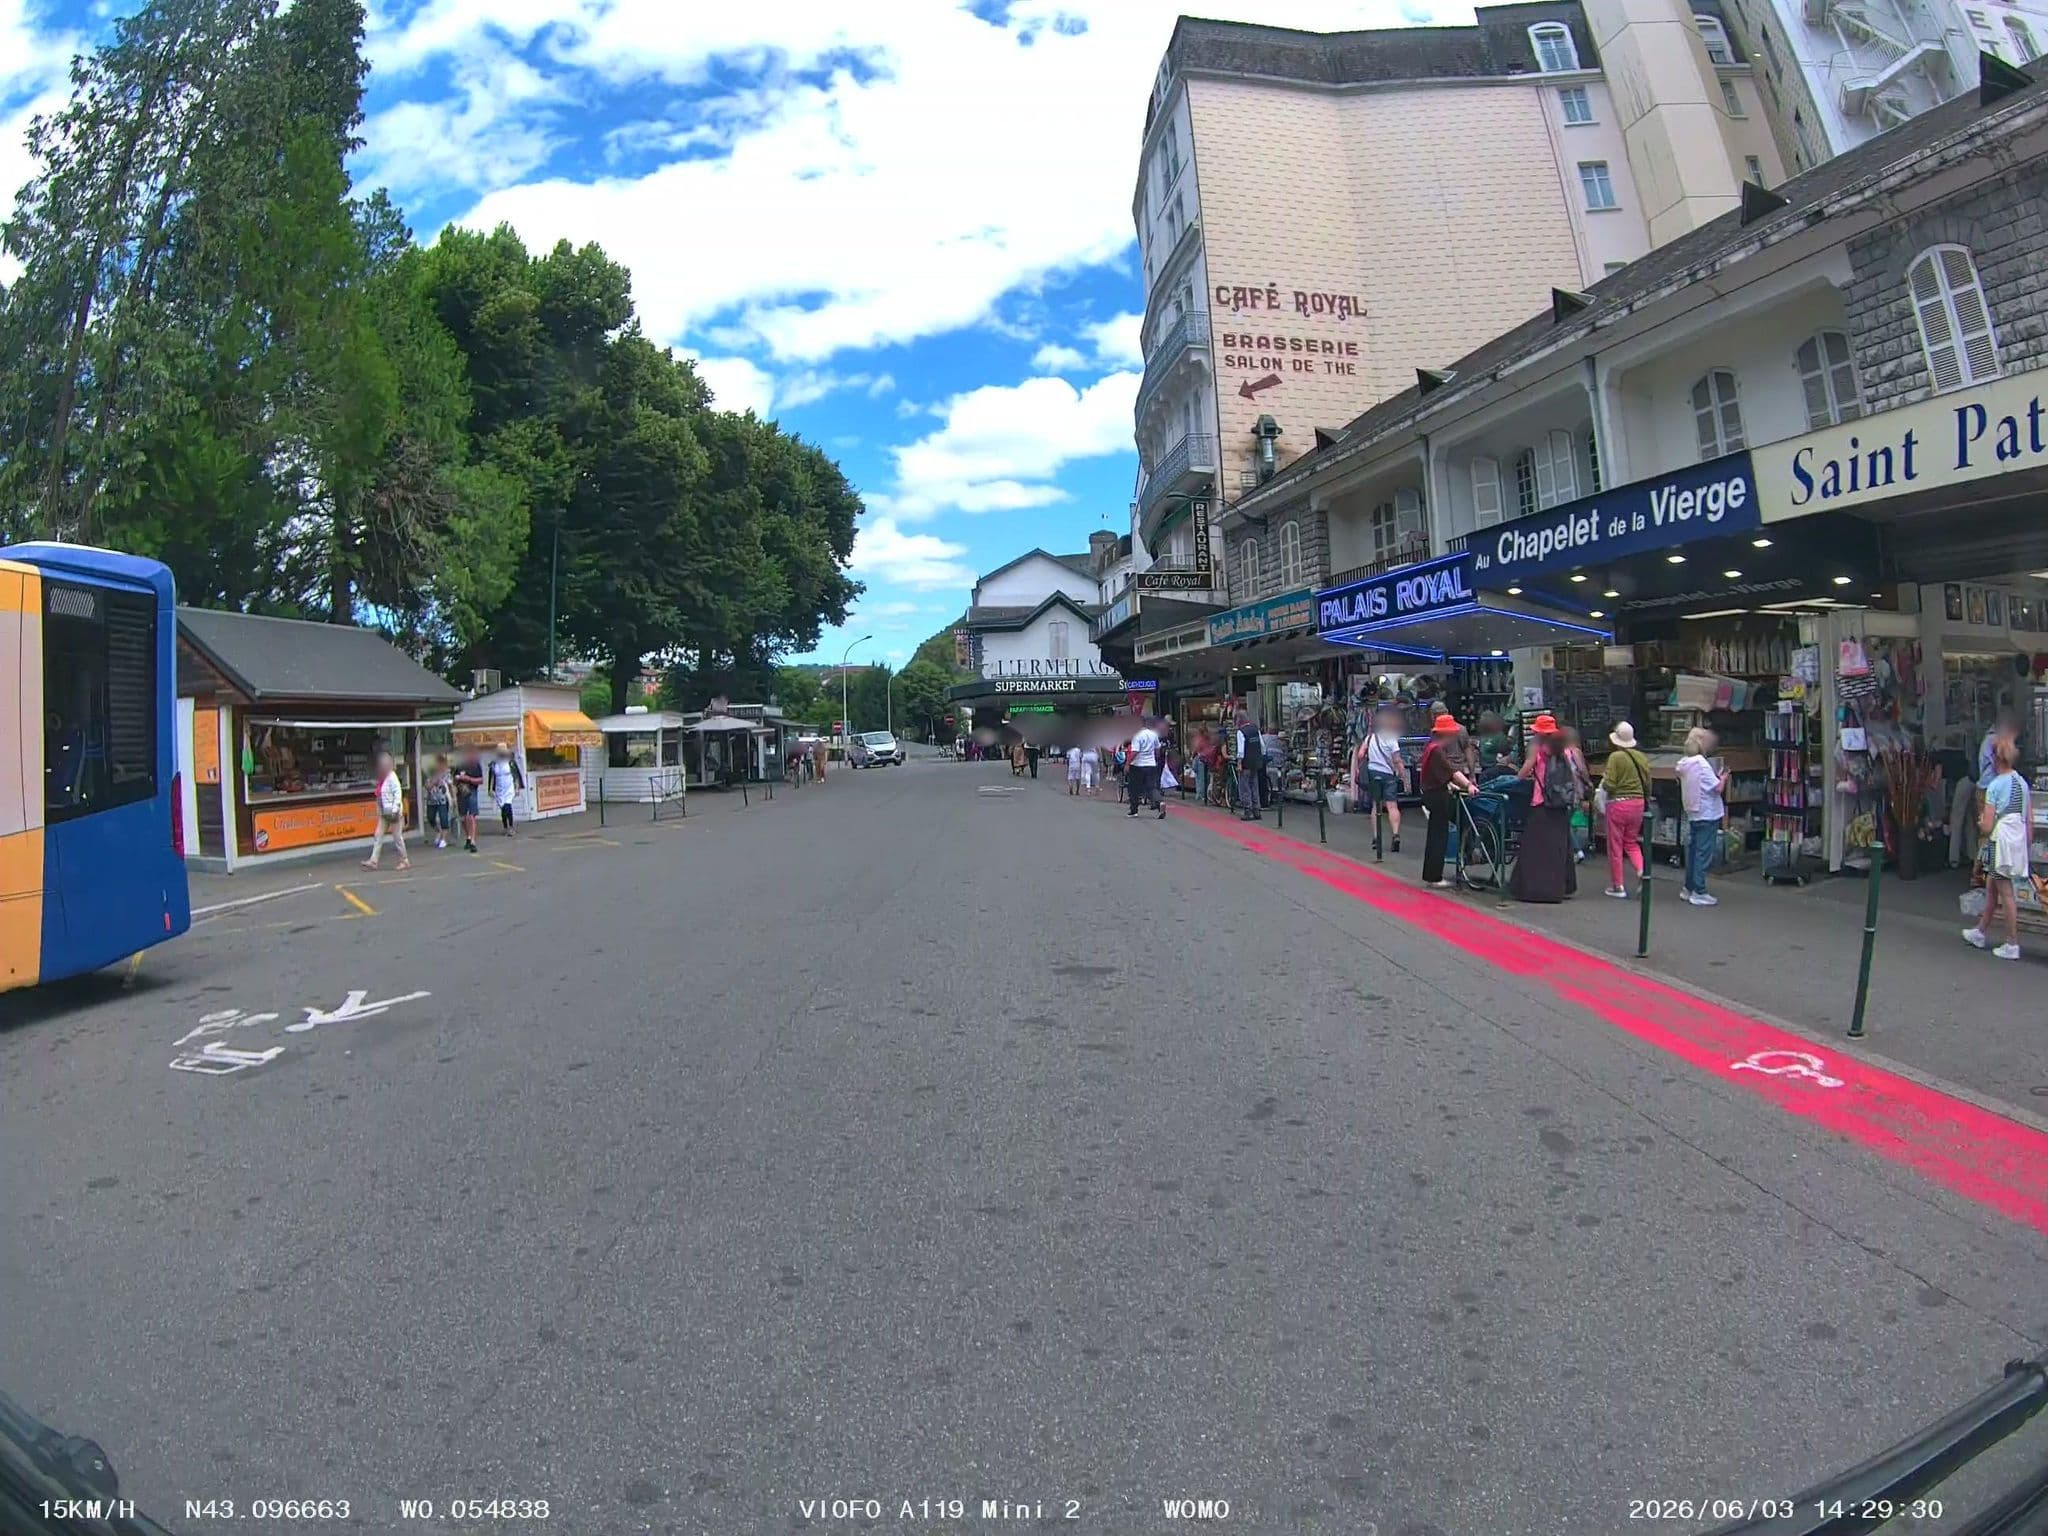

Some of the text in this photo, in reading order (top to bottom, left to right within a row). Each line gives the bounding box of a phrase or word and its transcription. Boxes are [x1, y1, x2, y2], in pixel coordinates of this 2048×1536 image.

[1216, 282, 1368, 321] CAFÉ ROYAL
[1222, 333, 1359, 356] BRASSERIE
[1224, 354, 1357, 375] SALON DE THE
[1790, 427, 1920, 506] Saint
[1195, 503, 1209, 571] RESTAURANT
[1474, 476, 1747, 571] Au Chapelet de la Vierge
[1171, 574, 1203, 588] Royal
[1320, 585, 1388, 627] PALAIS
[1396, 566, 1473, 611] ROYAL
[995, 680, 1077, 692] SUPERMARKET
